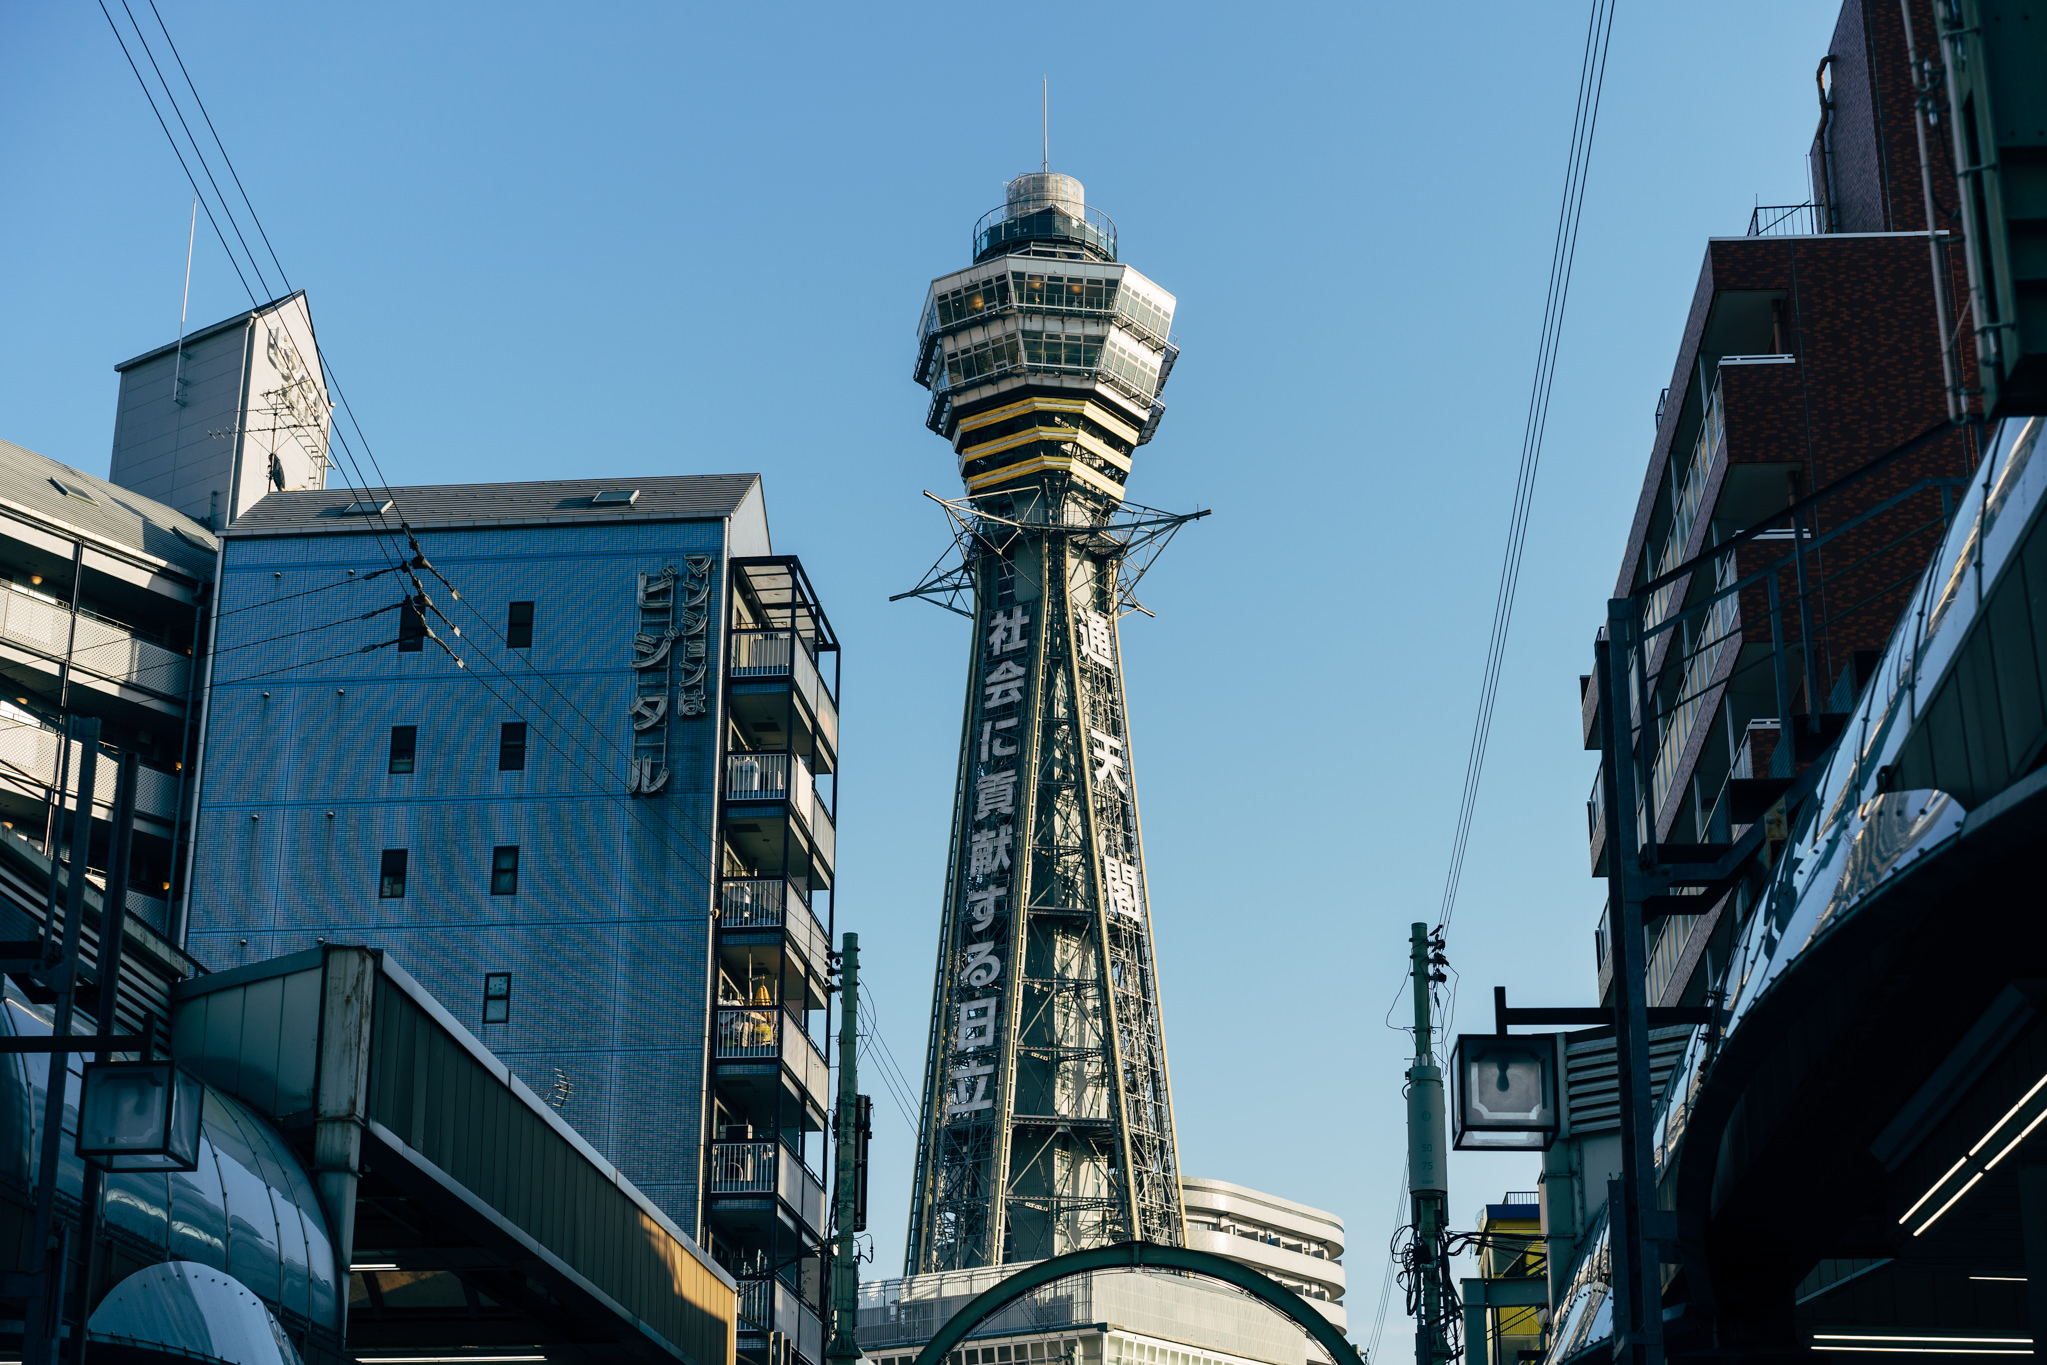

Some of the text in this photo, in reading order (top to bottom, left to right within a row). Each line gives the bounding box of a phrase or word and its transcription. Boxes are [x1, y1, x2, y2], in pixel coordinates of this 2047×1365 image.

[627, 565, 679, 794] ビジタル
[678, 553, 712, 716] マンションは
[1078, 606, 1141, 923] 通天閣
[947, 605, 1030, 1115] 社会に貢献する日立
